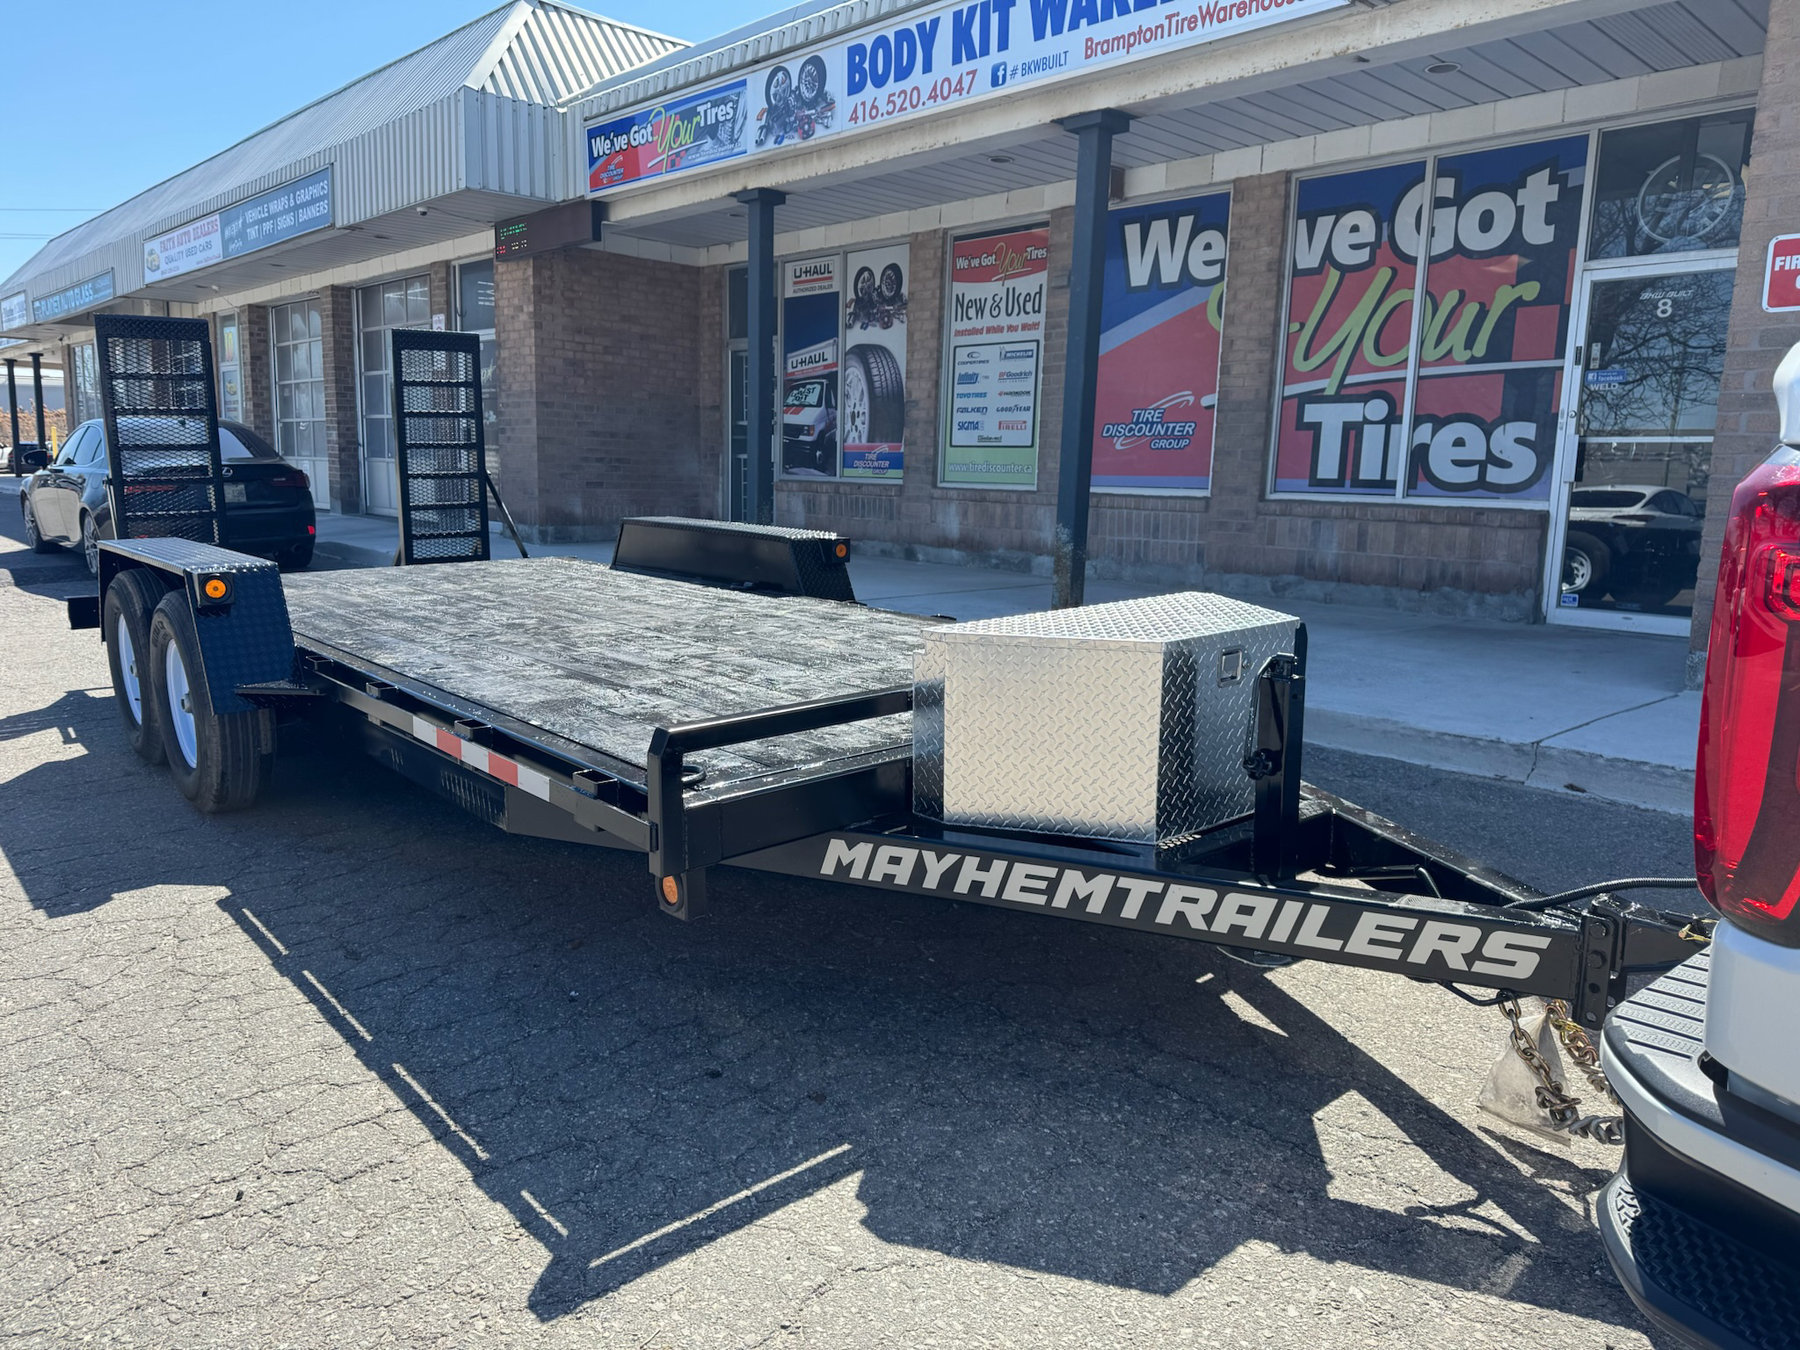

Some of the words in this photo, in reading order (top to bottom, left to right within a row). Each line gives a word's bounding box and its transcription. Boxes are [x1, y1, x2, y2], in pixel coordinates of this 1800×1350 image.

[847, 16, 941, 96] BODY
[952, 0, 1016, 66] KIT
[1021, 51, 1069, 77] BKWBUILT
[848, 69, 978, 124] 416.520.4047
[591, 132, 628, 158] We've
[629, 124, 654, 148] Got
[649, 107, 701, 174] Your
[697, 101, 735, 127] Tires
[245, 204, 268, 223] VEHICLE
[268, 195, 289, 215] WRAPS
[289, 193, 295, 206] &
[295, 180, 328, 205] GRAPHICS
[246, 224, 260, 241] TINT
[262, 219, 273, 236] PPF
[277, 212, 295, 230] SIGNS
[299, 200, 328, 223] BANNERS
[1124, 215, 1226, 287] We
[1394, 167, 1560, 258] Got
[185, 246, 198, 258] USED
[198, 240, 213, 253] CARS
[793, 263, 833, 279] U-HAUL
[956, 255, 980, 270] We've
[981, 252, 996, 267] Got
[994, 242, 1028, 287] Your
[1026, 246, 1048, 260] Tires
[954, 292, 988, 322] New
[989, 293, 1003, 319] &
[1005, 283, 1043, 317] Used
[1656, 299, 1673, 318] 8
[954, 326, 984, 337] Installed
[985, 325, 1005, 335] While
[1006, 324, 1019, 333] You
[1291, 266, 1541, 395] Your
[791, 352, 828, 369] U-HAUL
[998, 370, 1033, 378] BFGoodrich
[1590, 383, 1619, 391] WELD
[956, 406, 988, 414] FALKEN
[996, 404, 1031, 413] GOODYEAR
[1131, 409, 1165, 422] TIRE
[957, 420, 979, 431] SIGMA
[998, 420, 1027, 431] PIRELLI
[1102, 422, 1196, 437] DISCOUNTER
[1150, 439, 1190, 449] GROUP
[1302, 398, 1538, 485] Tires
[853, 460, 890, 468] DISCOUNTER
[948, 461, 1033, 473] www.tirediscounter.ca
[819, 838, 1552, 980] MAYHEMTRAILERS
